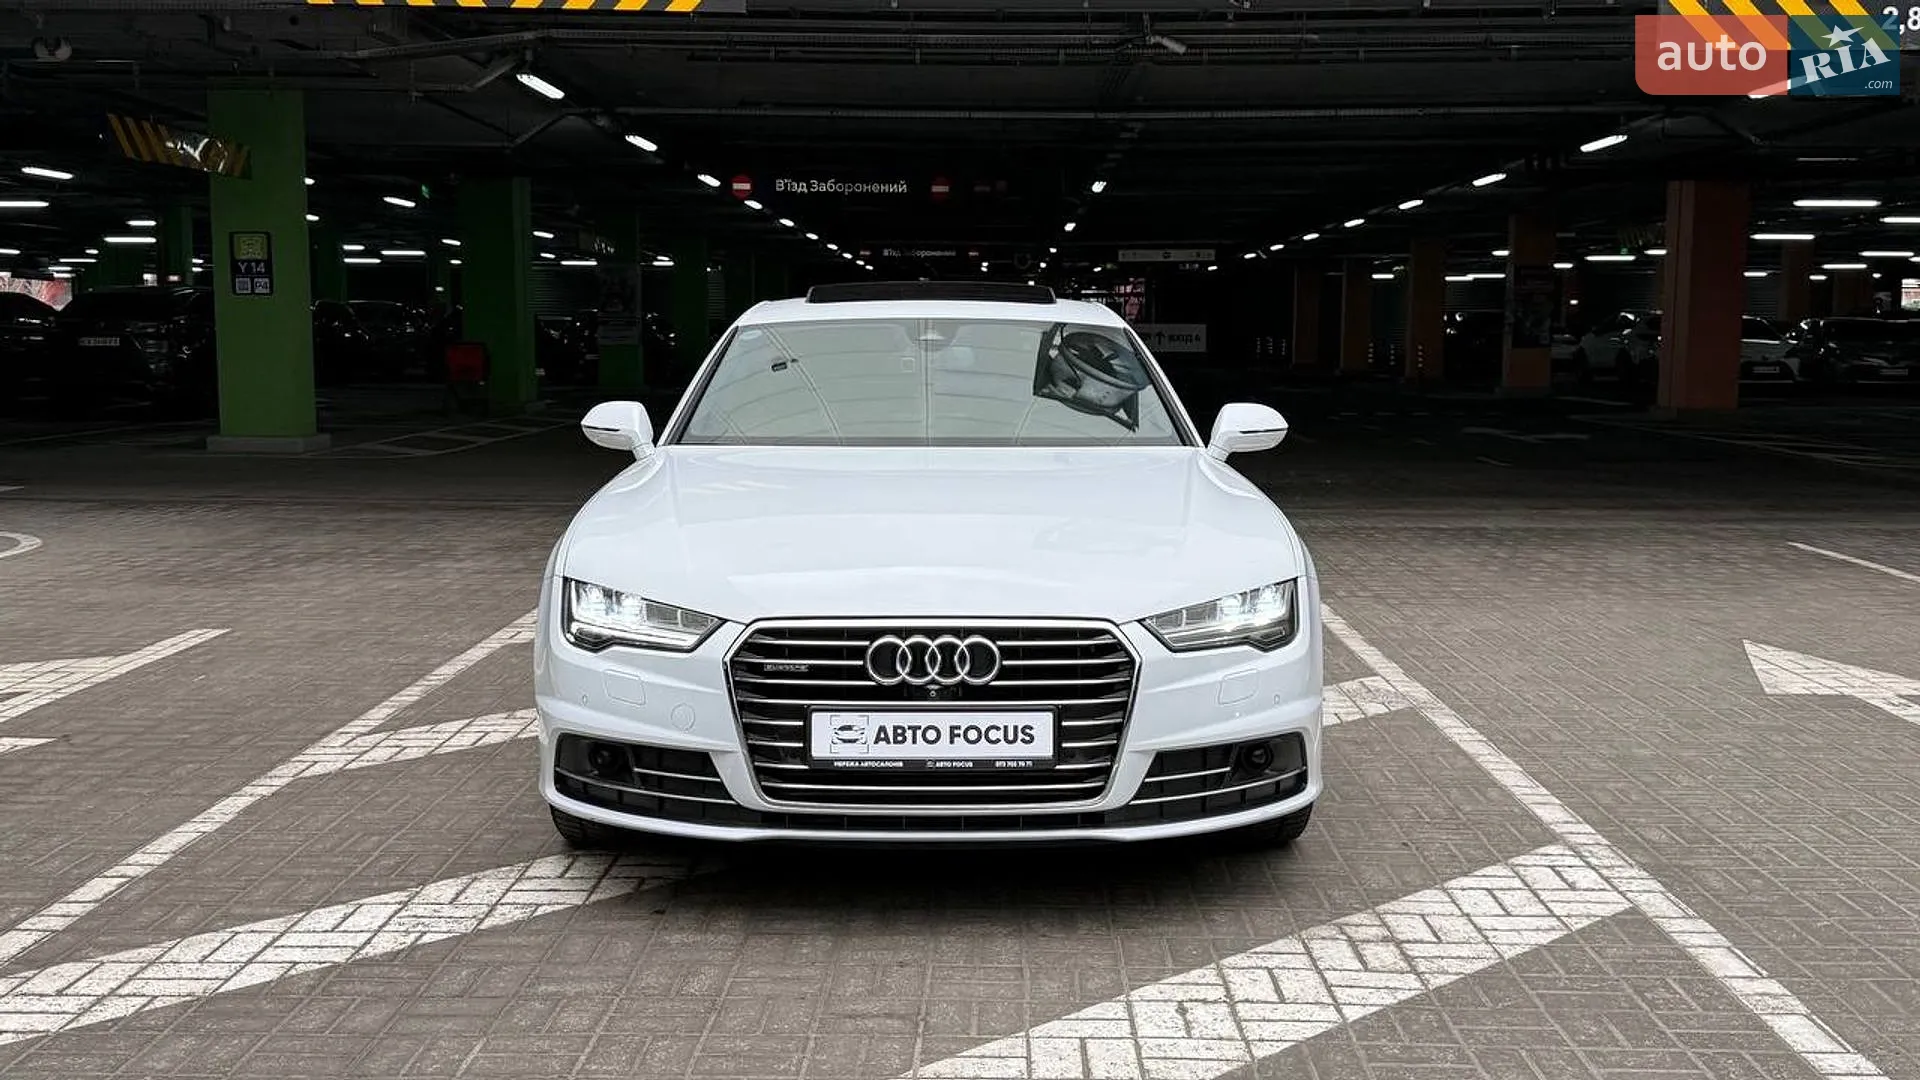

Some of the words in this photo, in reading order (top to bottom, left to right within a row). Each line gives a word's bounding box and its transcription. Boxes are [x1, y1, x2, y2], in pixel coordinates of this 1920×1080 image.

[809, 178, 908, 195] Заборонений
[250, 261, 266, 274] 14
[873, 724, 942, 745] АВТО
[949, 724, 1035, 745] FOCUS
